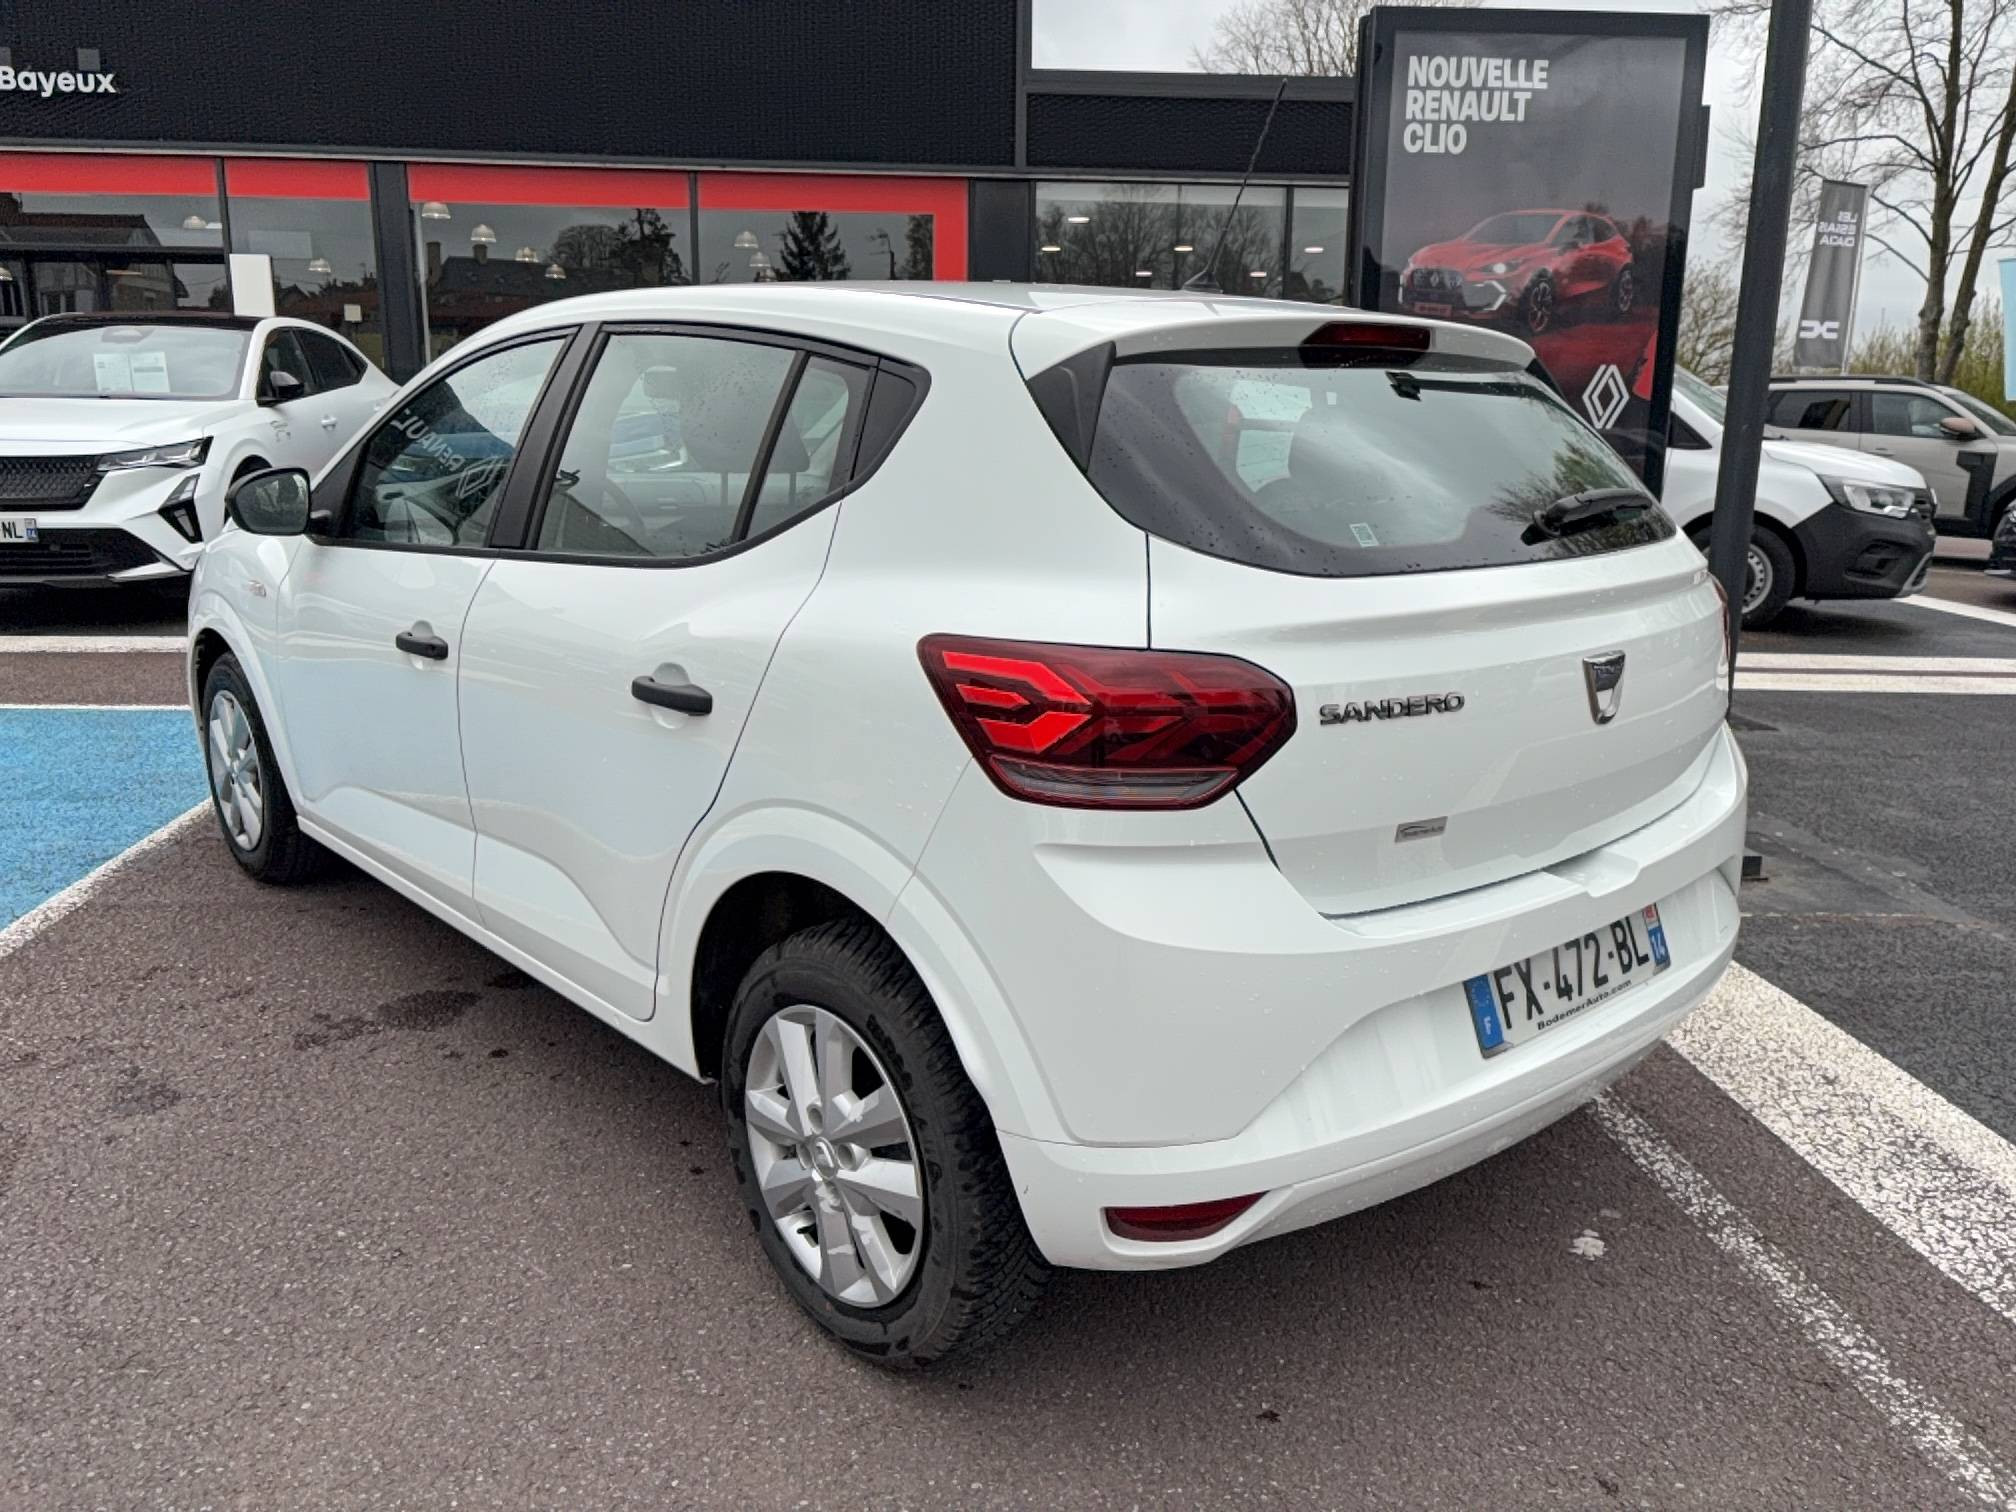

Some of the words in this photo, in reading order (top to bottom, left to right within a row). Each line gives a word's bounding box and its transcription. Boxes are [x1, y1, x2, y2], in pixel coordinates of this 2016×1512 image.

[0, 65, 117, 98] Bayeux
[1407, 55, 1550, 89] NOUVELLE
[1405, 89, 1533, 122] RENAULT
[1403, 122, 1468, 155] CLIO
[1318, 691, 1466, 726] SANDERO
[1537, 979, 1633, 1031] BodemerAuto.com
